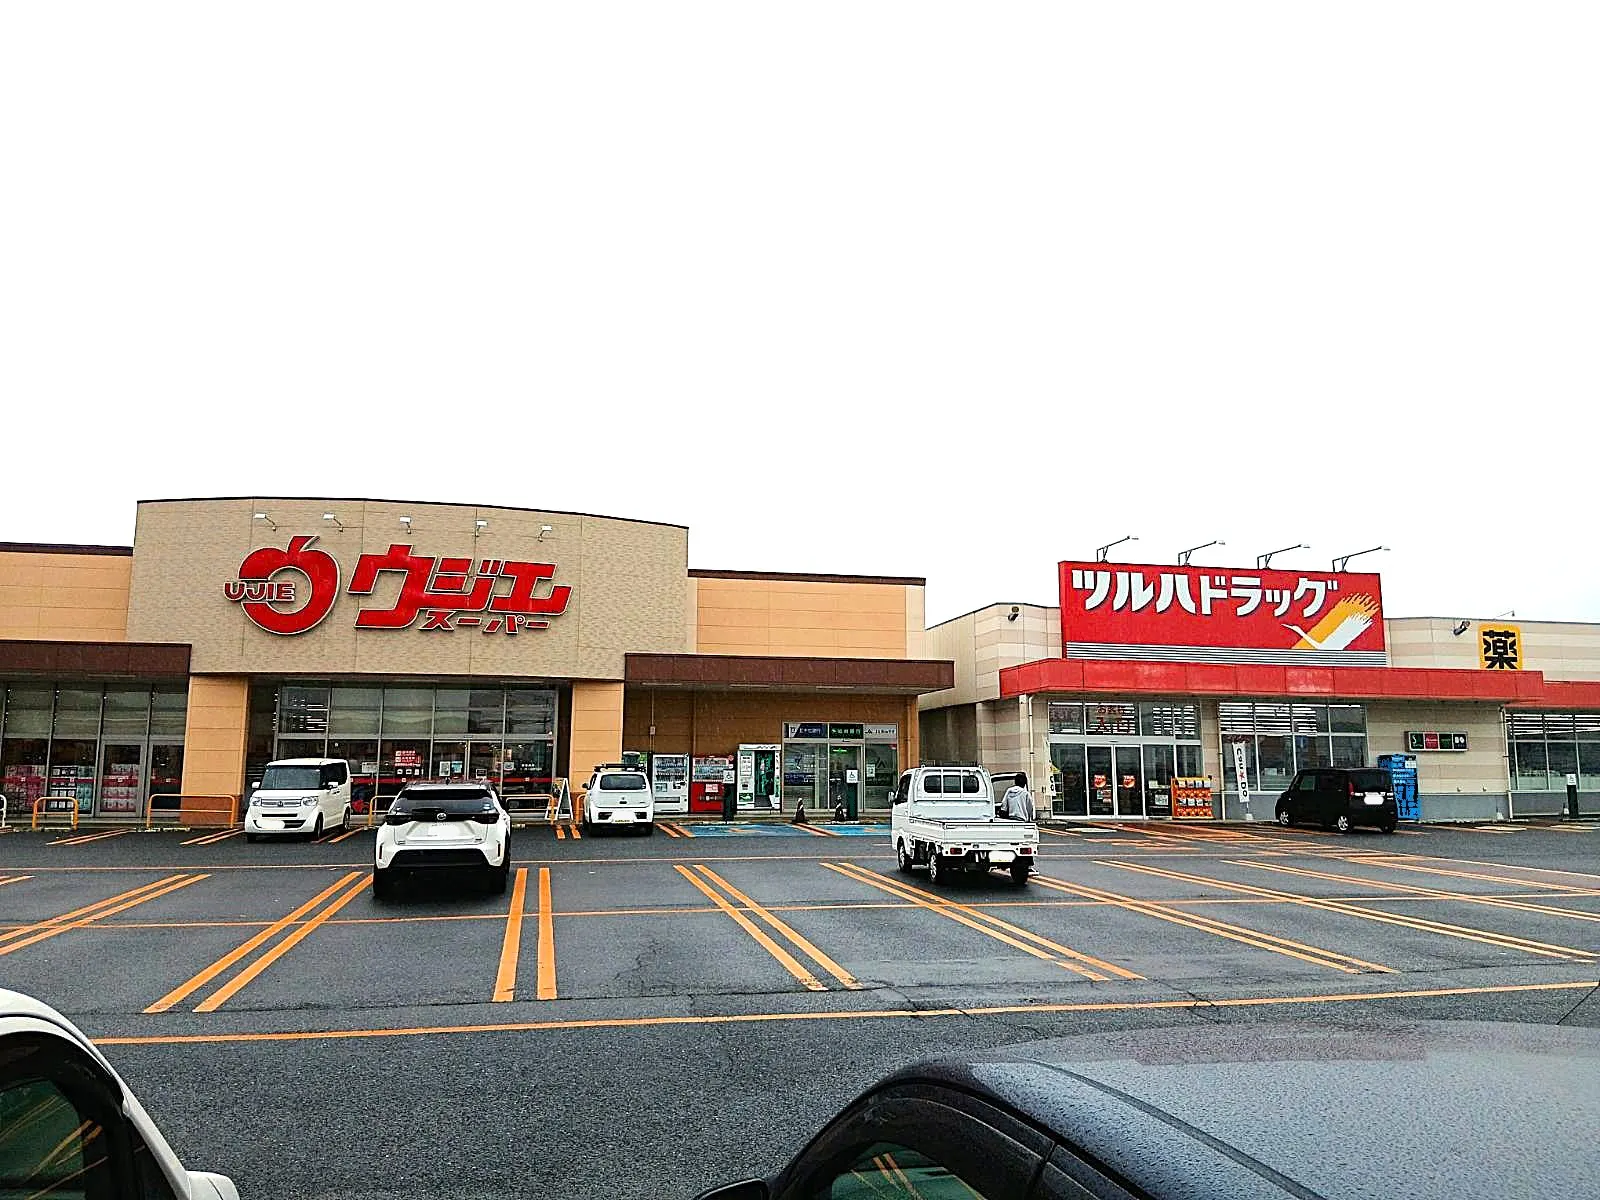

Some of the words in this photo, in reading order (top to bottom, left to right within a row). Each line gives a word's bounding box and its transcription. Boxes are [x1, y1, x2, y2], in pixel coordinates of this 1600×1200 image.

[223, 581, 296, 603] UJIE
[346, 543, 575, 629] ウジエ
[1071, 569, 1340, 618] ツルハドラッグ
[417, 609, 551, 635] スーパー
[1482, 628, 1519, 670] 薬
